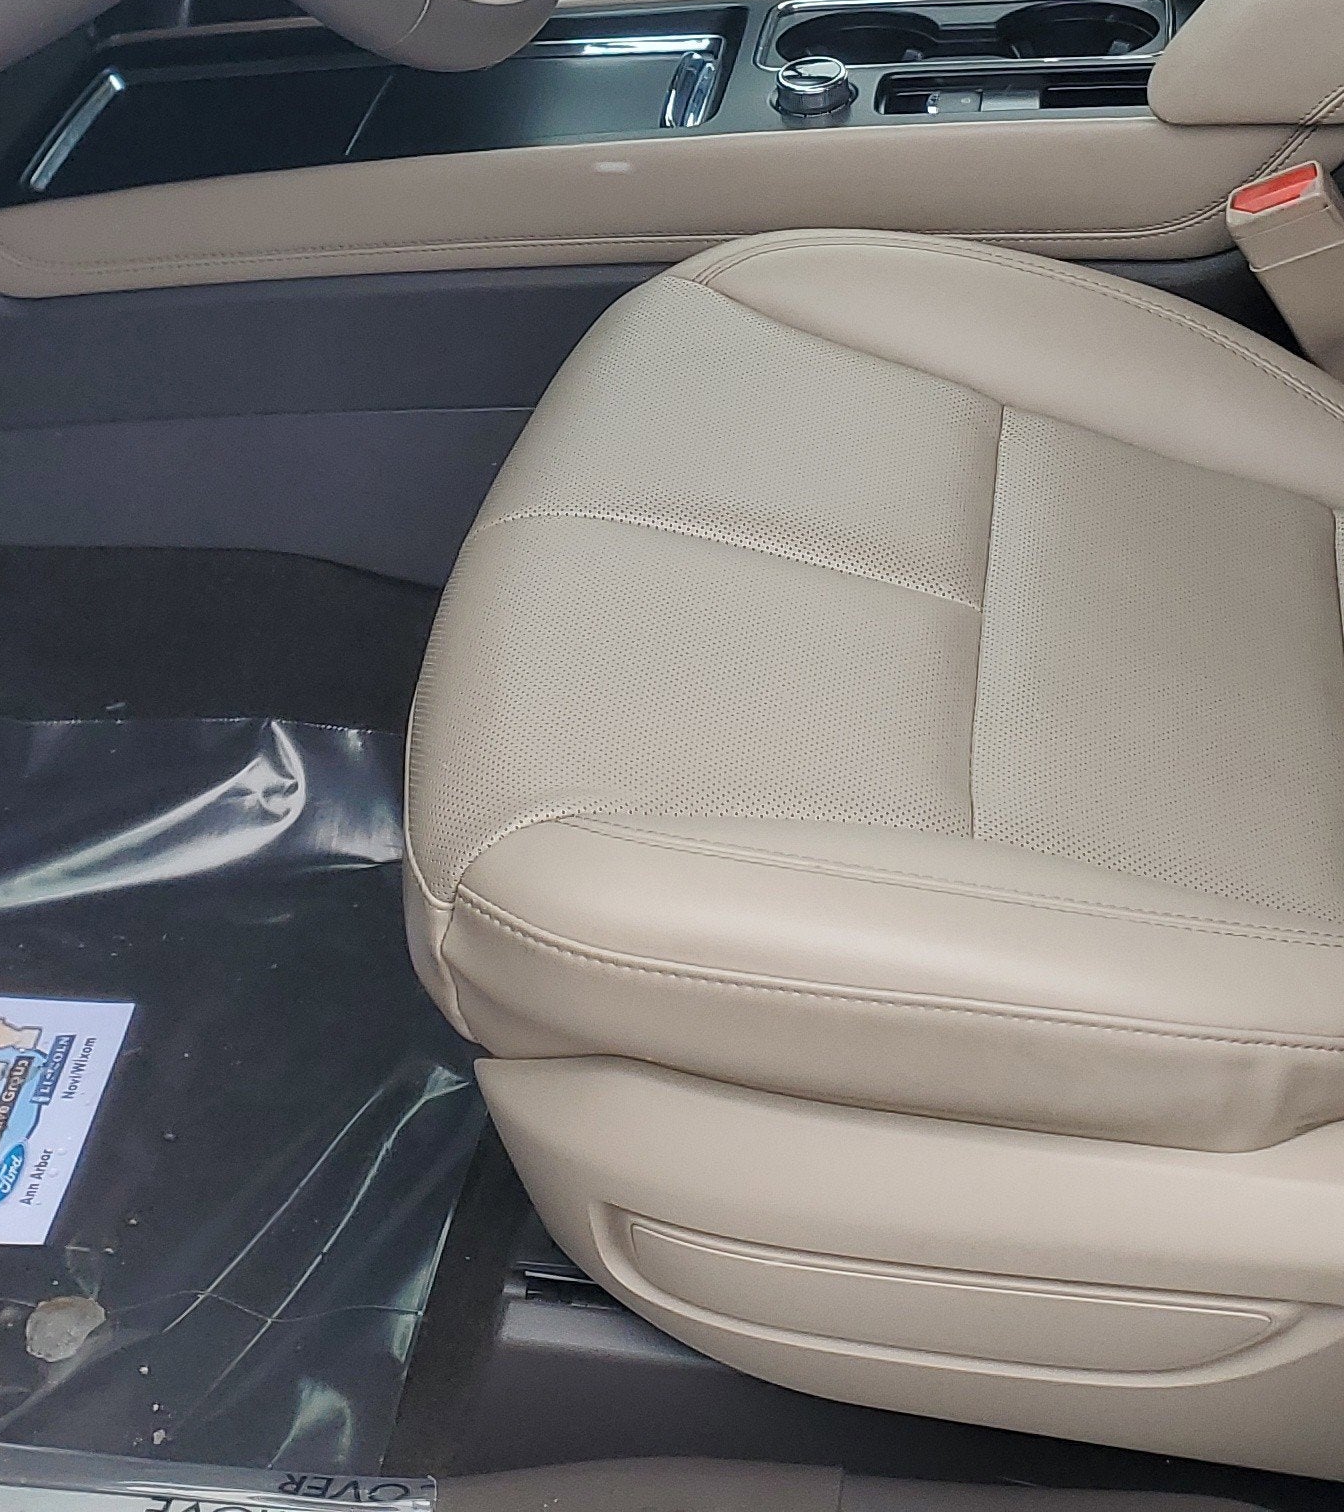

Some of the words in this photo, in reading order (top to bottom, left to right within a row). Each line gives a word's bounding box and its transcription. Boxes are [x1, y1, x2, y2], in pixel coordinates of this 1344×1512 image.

[61, 1037, 97, 1099] Novi/Wixom
[30, 1148, 55, 1182] Arbor
[19, 1180, 42, 1206] Ann
[278, 1473, 435, 1502] OVER
